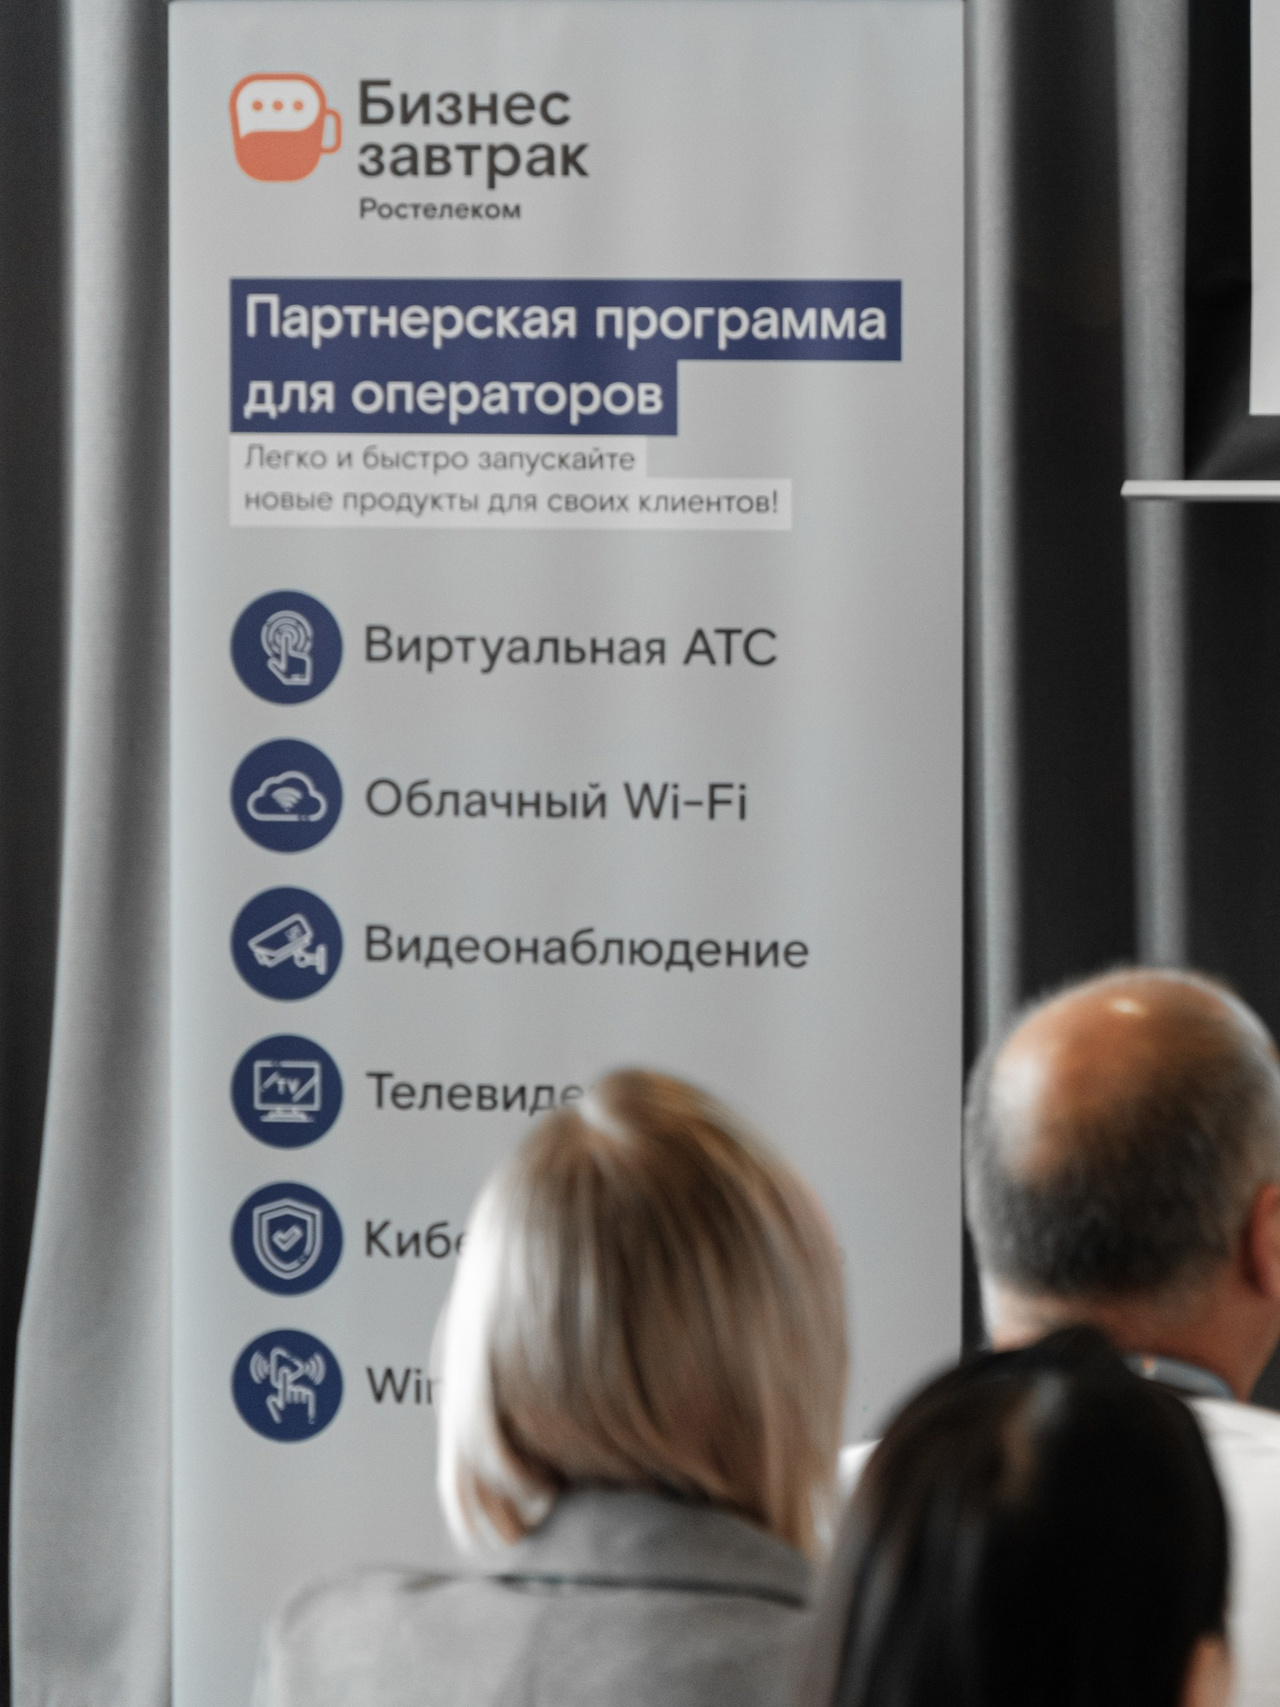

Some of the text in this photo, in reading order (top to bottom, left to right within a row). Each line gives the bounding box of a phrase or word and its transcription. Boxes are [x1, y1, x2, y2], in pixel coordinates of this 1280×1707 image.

[358, 79, 571, 127] Бизнес
[357, 140, 590, 189] завтрак
[358, 196, 522, 221] Ростелеком
[245, 293, 888, 352] Партнерская программа
[242, 380, 664, 427] для операторов
[244, 443, 637, 477] Легко и быстро запускайте
[243, 489, 780, 519] новые продукты для своих клиентов!
[364, 624, 778, 674] Виртуальная АТС
[364, 776, 608, 820] Облачный
[364, 924, 810, 973] Видеонаблюдение
[364, 1070, 585, 1117] Телевиде
